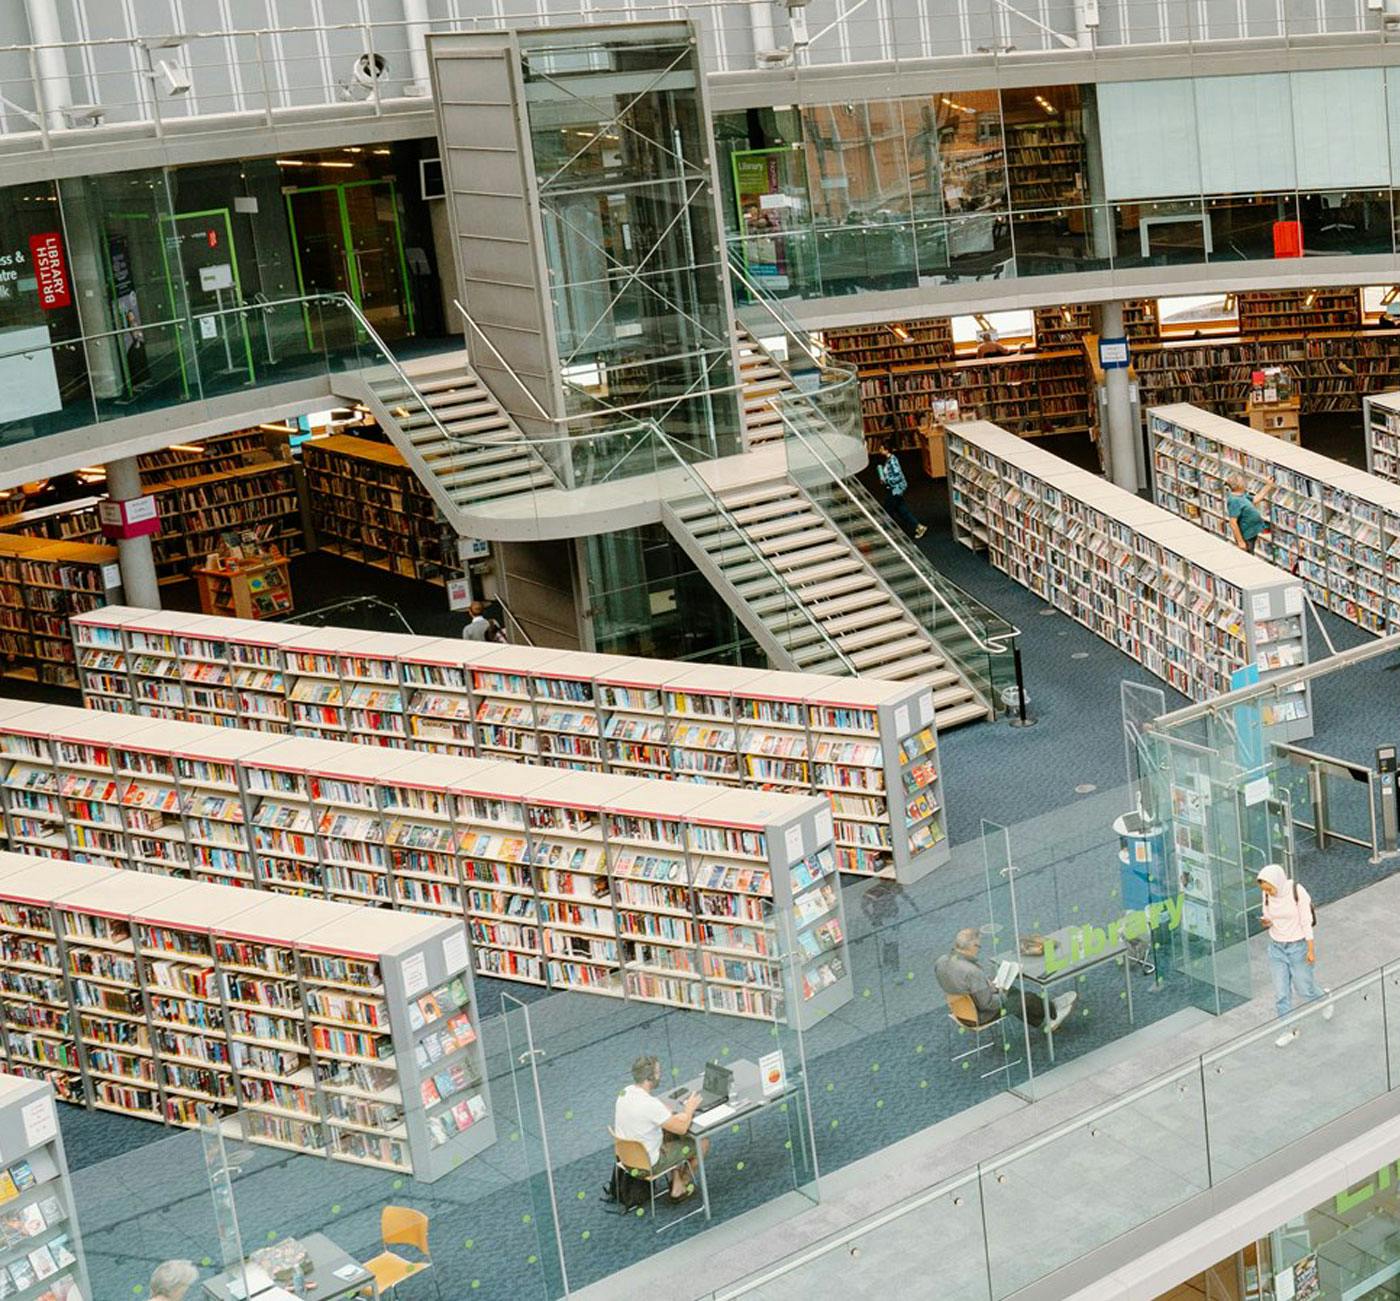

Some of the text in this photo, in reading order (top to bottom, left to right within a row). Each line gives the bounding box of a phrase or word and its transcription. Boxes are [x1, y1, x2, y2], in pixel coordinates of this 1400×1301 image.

[36, 247, 56, 303] BRITISH
[46, 238, 64, 294] LIBRARY
[1043, 891, 1185, 974] Library
